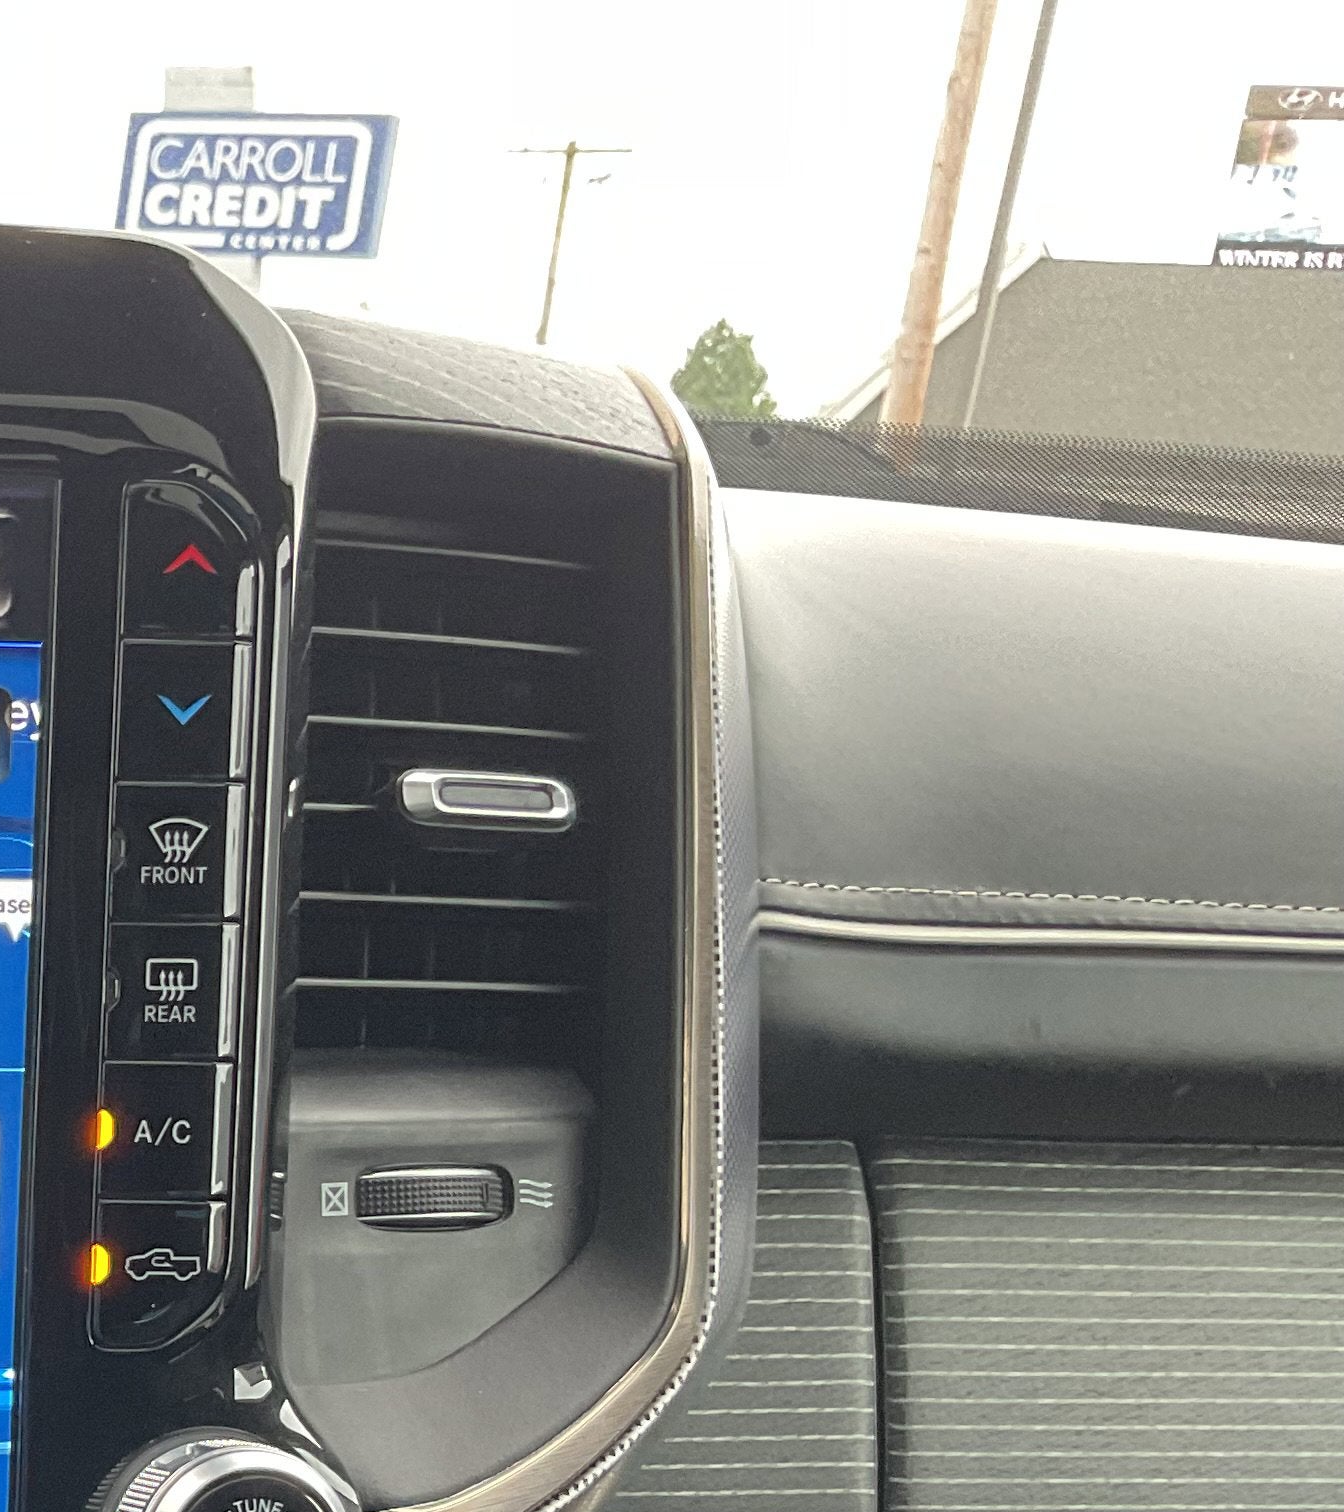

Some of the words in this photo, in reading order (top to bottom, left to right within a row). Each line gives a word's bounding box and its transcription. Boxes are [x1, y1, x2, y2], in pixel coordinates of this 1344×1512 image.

[150, 138, 348, 184] CARROLL
[142, 183, 337, 230] CREDIT
[141, 866, 208, 884] FRONT
[144, 1005, 196, 1023] REAR
[134, 1120, 191, 1144] A/C
